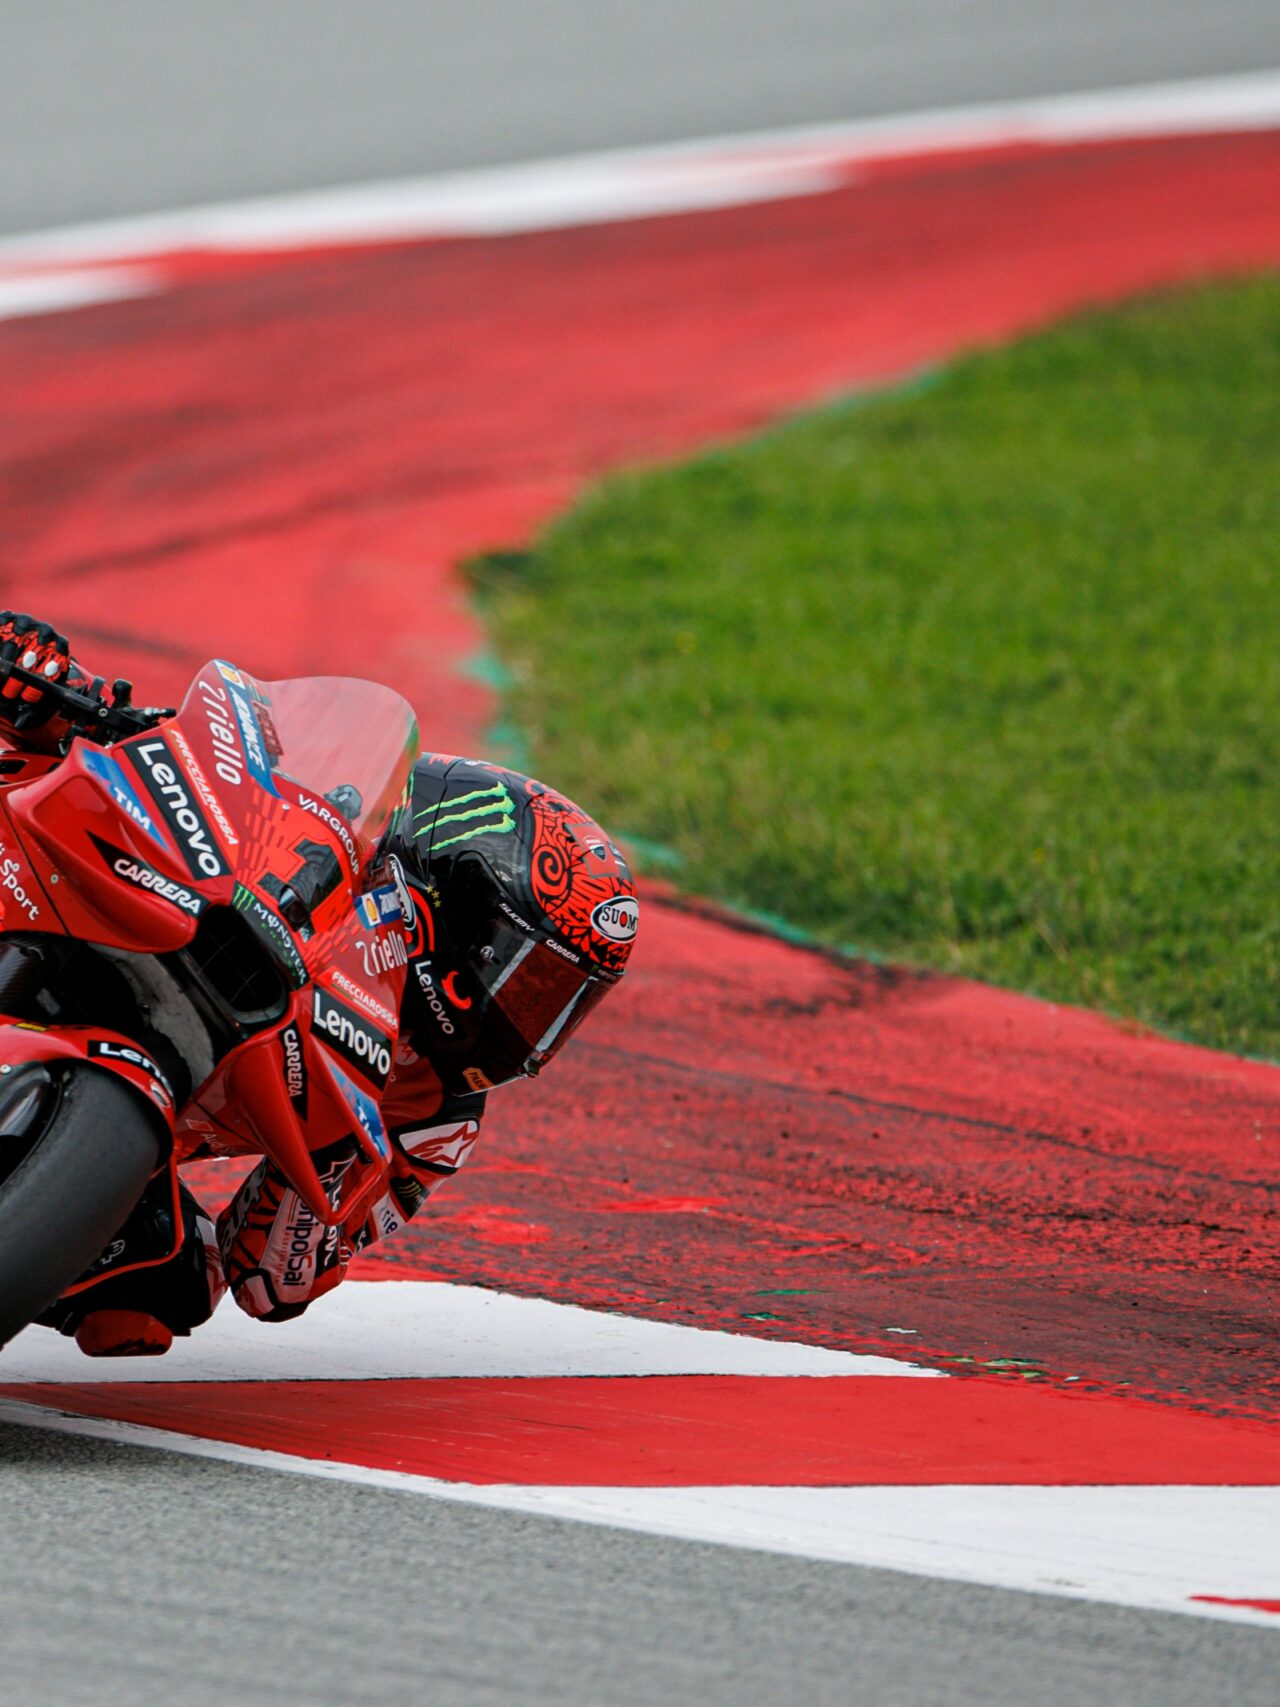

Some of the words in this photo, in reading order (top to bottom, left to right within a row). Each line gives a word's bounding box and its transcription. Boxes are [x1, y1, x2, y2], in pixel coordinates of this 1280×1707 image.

[114, 787, 151, 831] TIM
[137, 742, 221, 877] Lenovo
[298, 793, 360, 876] VARGROUP
[0, 858, 40, 921] Sport
[114, 858, 201, 915] CARRERA
[545, 938, 581, 965] CARRERA
[331, 971, 399, 1029] FRECCIAROSSA
[414, 959, 455, 1035] Lenovo
[283, 1029, 303, 1097] CARRERA
[313, 991, 391, 1076] Lenovo
